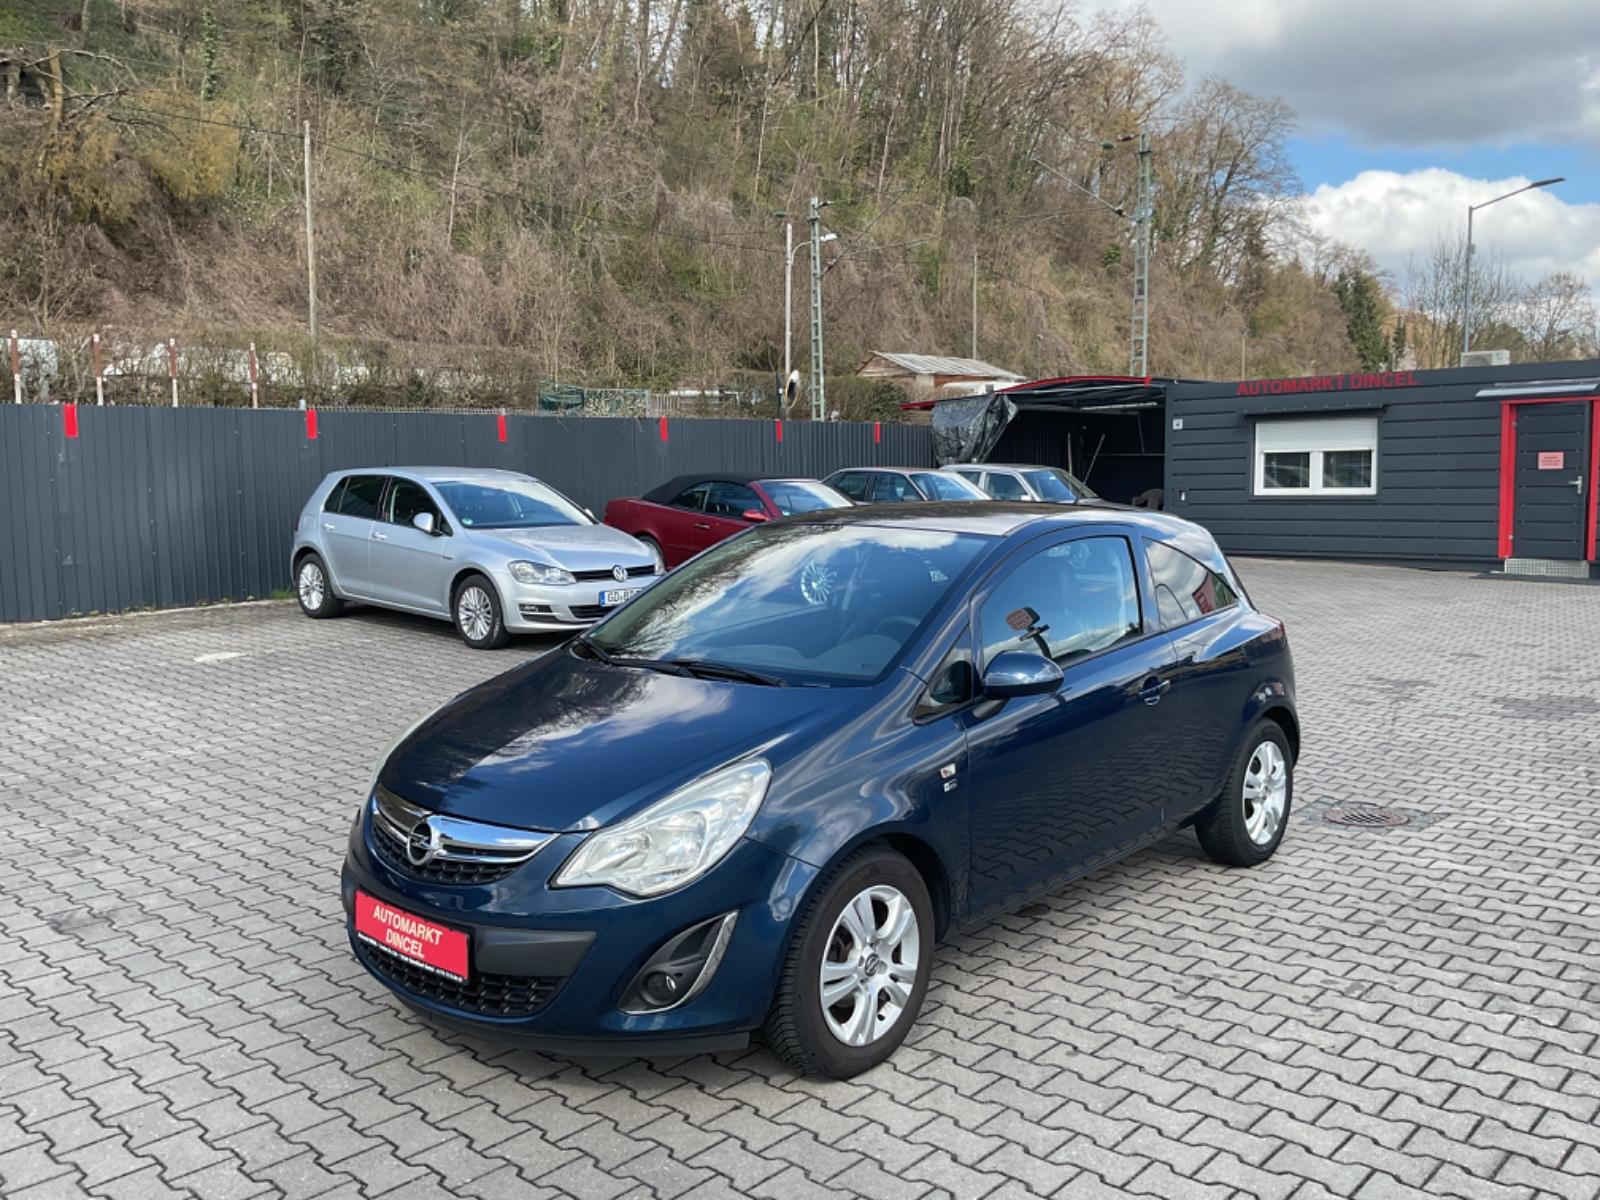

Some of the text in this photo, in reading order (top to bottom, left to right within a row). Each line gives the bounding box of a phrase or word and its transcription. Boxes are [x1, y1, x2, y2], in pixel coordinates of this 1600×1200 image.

[1236, 371, 1419, 396] AUTOMARKT DINCEL
[373, 905, 443, 945] AUTOMARKT
[385, 928, 425, 958] DINCEL
